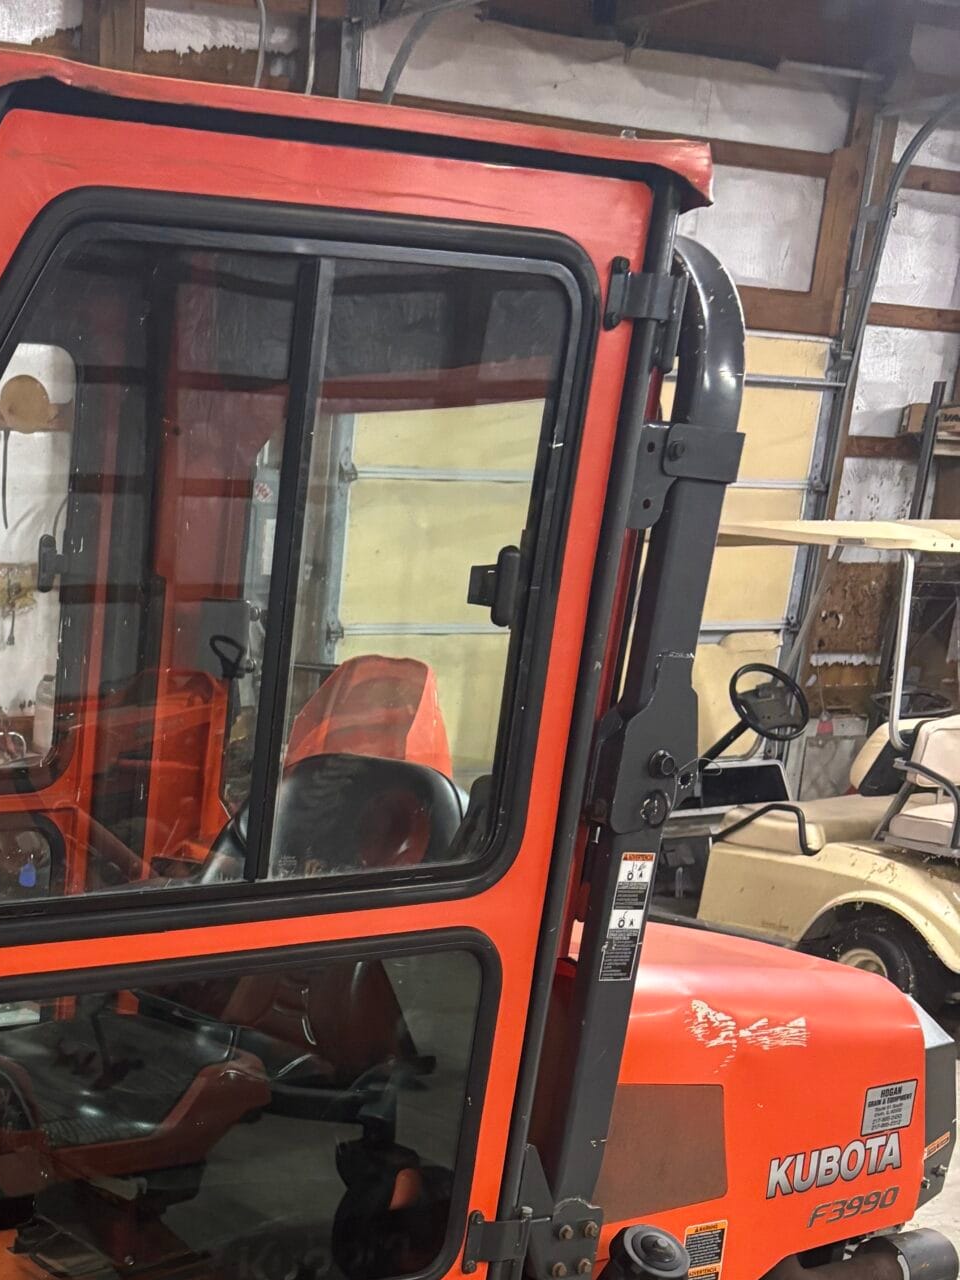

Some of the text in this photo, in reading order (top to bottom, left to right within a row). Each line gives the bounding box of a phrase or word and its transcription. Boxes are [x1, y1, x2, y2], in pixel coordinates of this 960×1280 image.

[880, 1085, 903, 1098] HOGAN
[765, 1131, 902, 1200] KUBOTA
[806, 1186, 900, 1228] F3990
